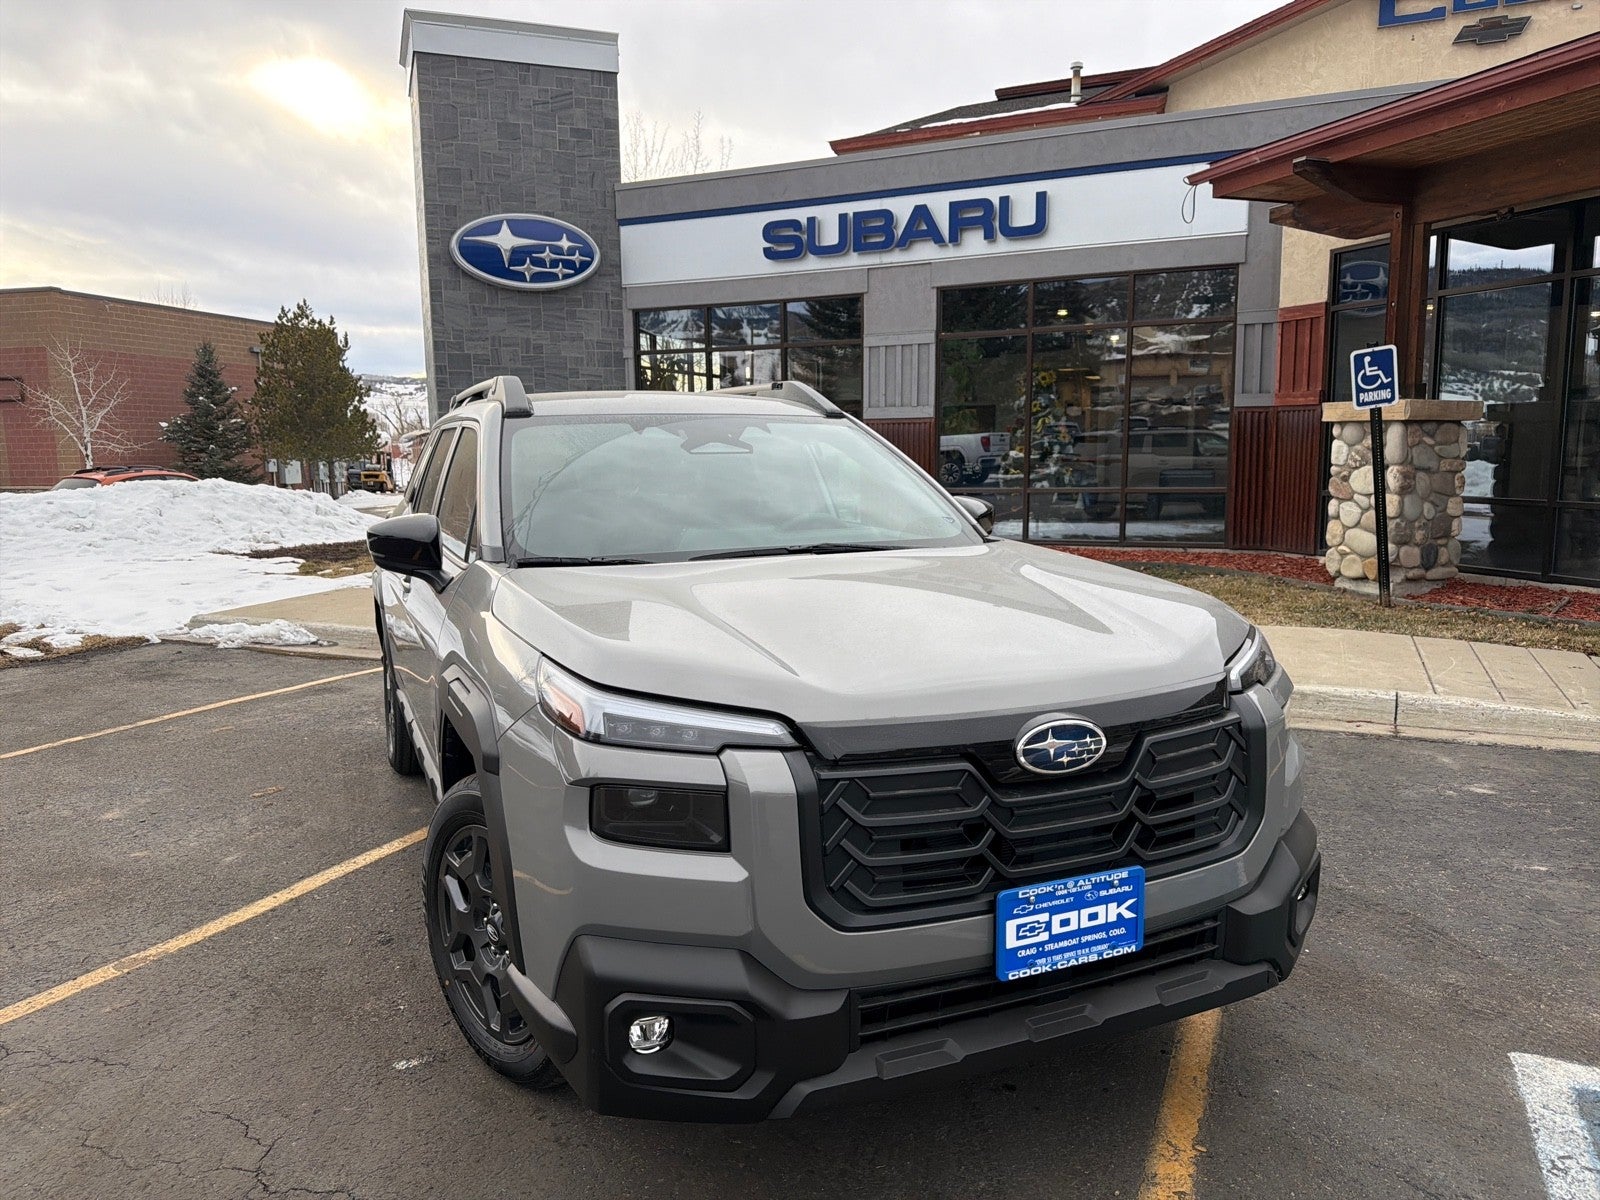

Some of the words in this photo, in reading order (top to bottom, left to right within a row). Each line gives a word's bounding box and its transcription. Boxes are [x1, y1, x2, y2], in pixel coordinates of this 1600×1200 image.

[762, 191, 1048, 261] SUBARU
[1359, 388, 1392, 403] PARKING
[1077, 871, 1129, 886] ALTITUDE
[1035, 896, 1074, 909] CHEVROLET
[1099, 885, 1133, 897] SUBARU
[1005, 898, 1138, 950] COOK
[1017, 947, 1037, 958] CRAIG
[1044, 938, 1080, 952] STEAMBOAT
[1080, 931, 1108, 944] SPRINGS,
[1109, 927, 1127, 937] COLO.
[1008, 944, 1136, 981] COOK-CARS.COM
